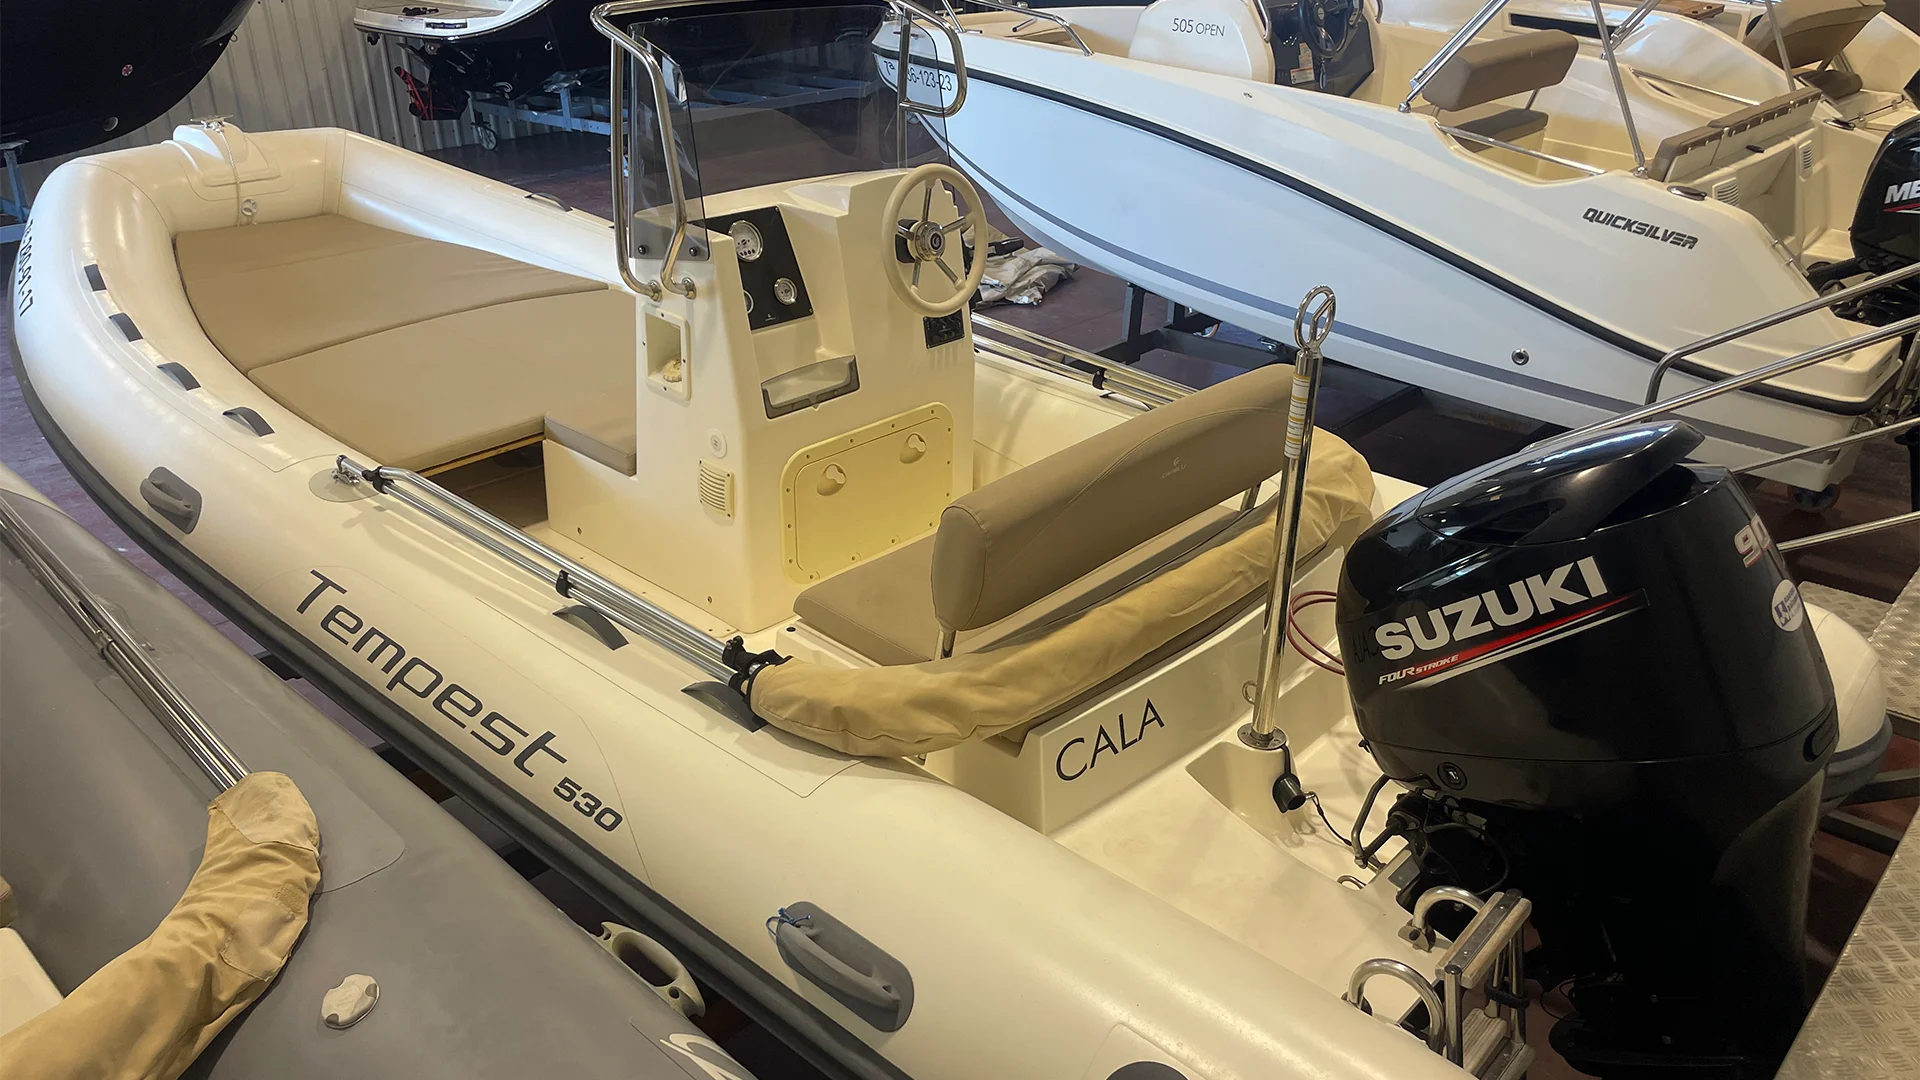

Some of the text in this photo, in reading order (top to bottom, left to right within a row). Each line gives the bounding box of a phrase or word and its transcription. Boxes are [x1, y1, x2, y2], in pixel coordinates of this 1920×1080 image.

[1172, 17, 1226, 37] 505 OPEN
[1582, 207, 1699, 250] QUICKSILVER
[1375, 555, 1608, 661] SUZUKI
[296, 569, 623, 832] Tempest 530
[1378, 654, 1459, 686] FOUR STROKE
[1056, 698, 1165, 781] CALA
